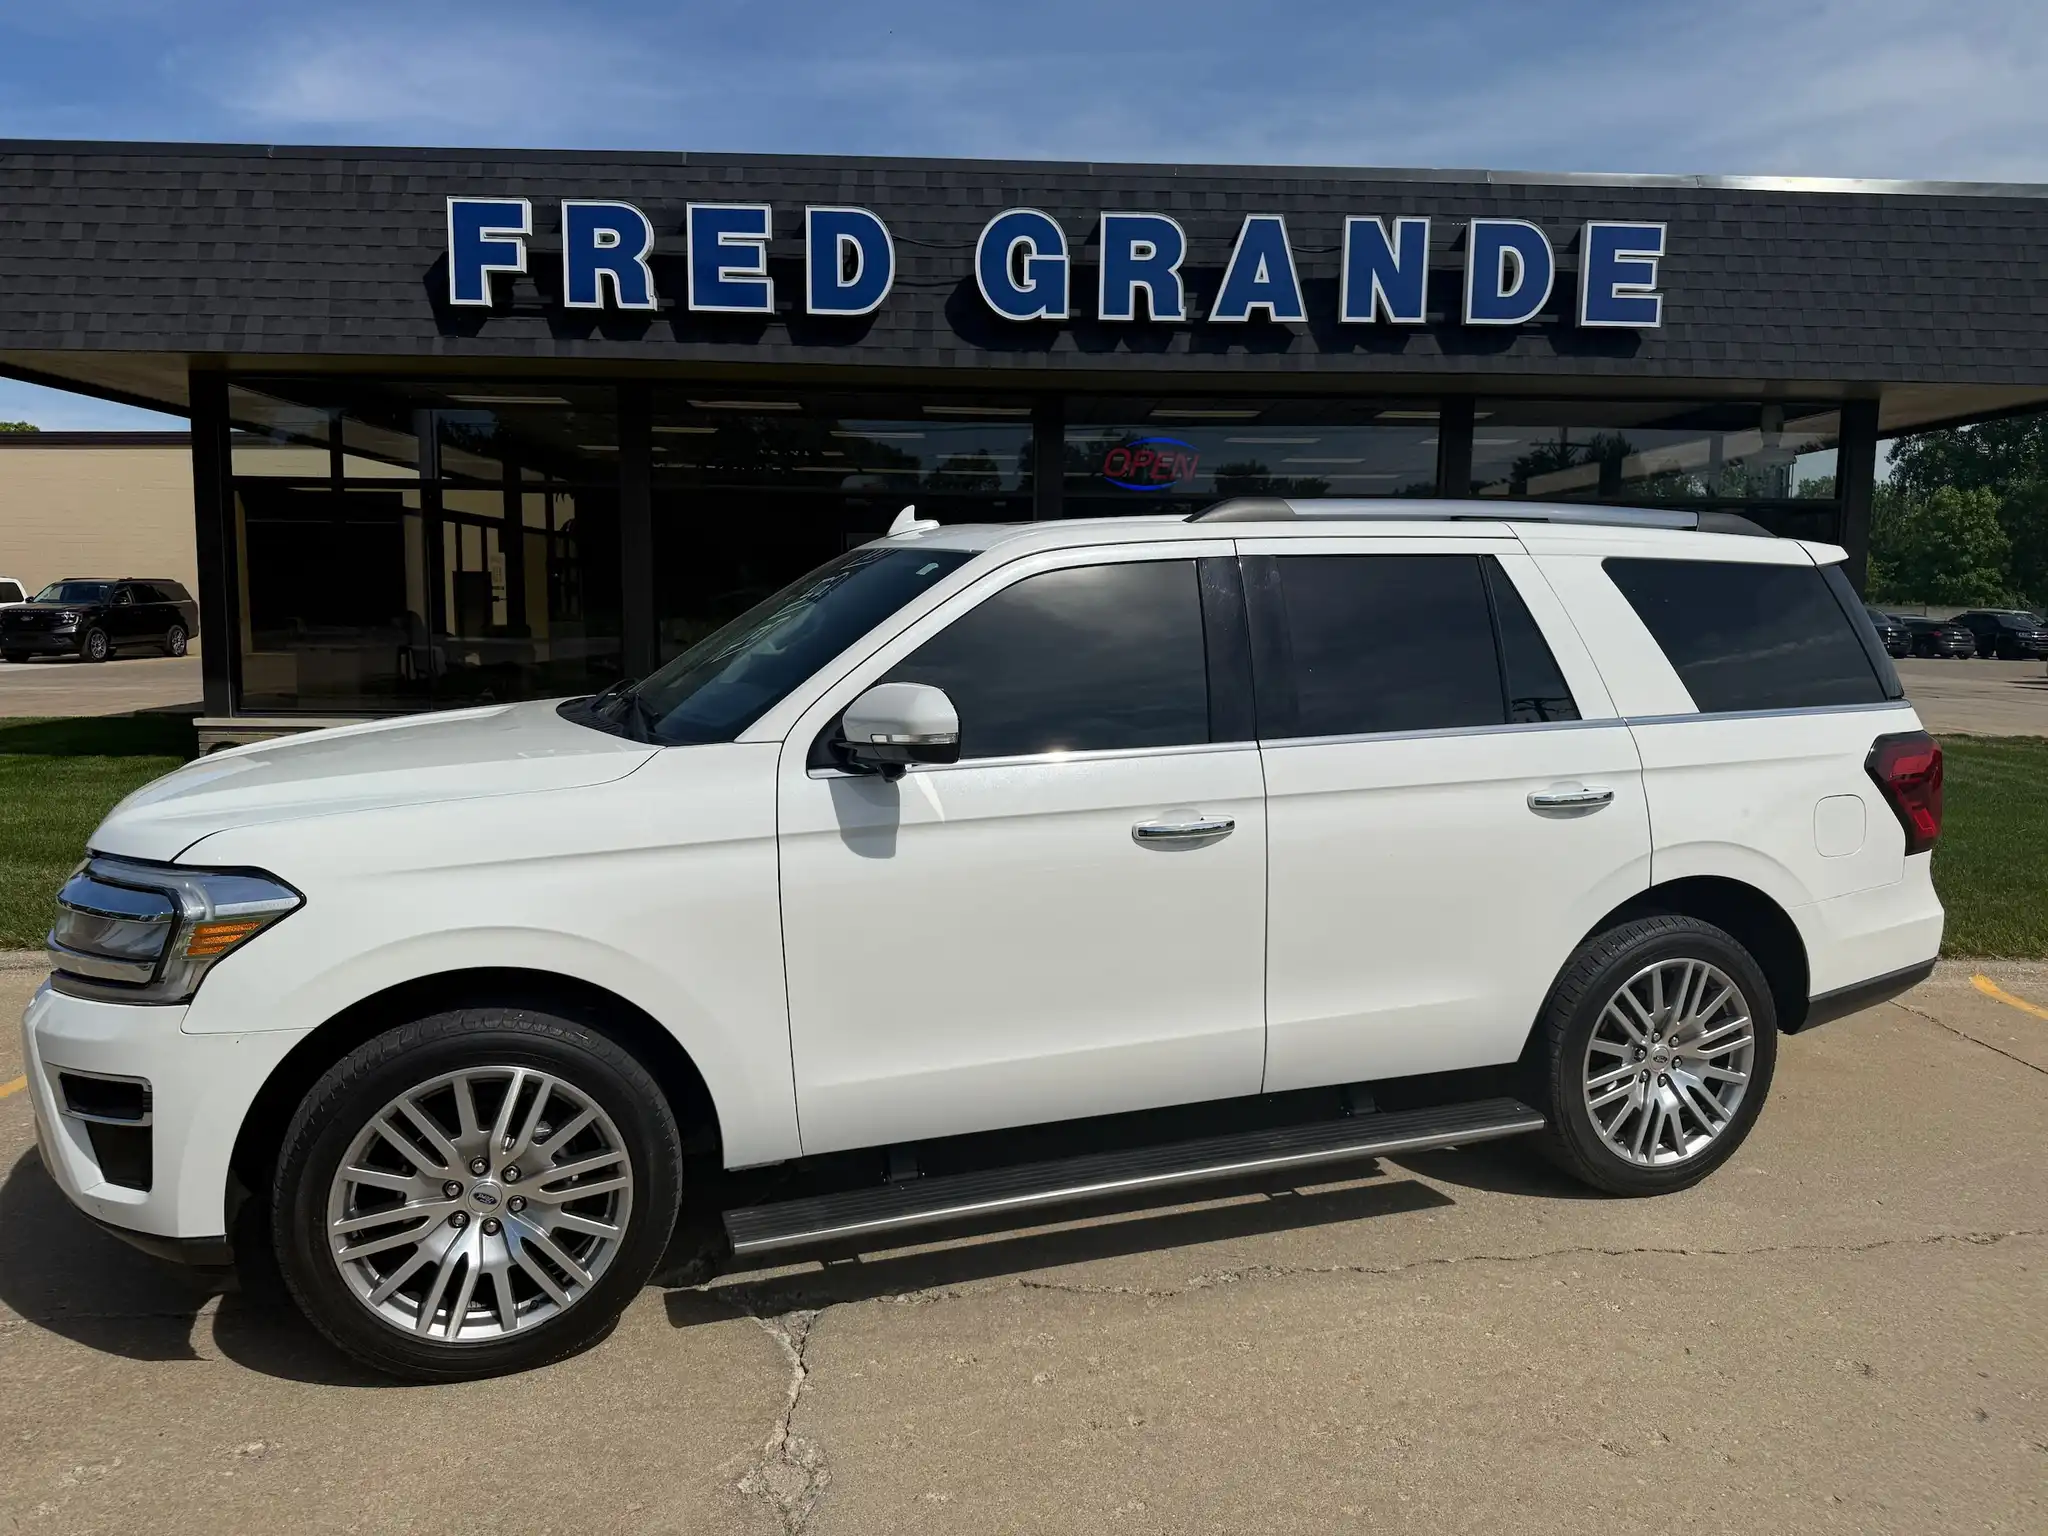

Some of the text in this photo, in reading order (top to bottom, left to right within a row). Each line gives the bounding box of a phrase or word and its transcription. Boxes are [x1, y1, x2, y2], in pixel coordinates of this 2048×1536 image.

[447, 196, 1667, 328] FRED GRANDE
[1104, 448, 1199, 482] OPEN
